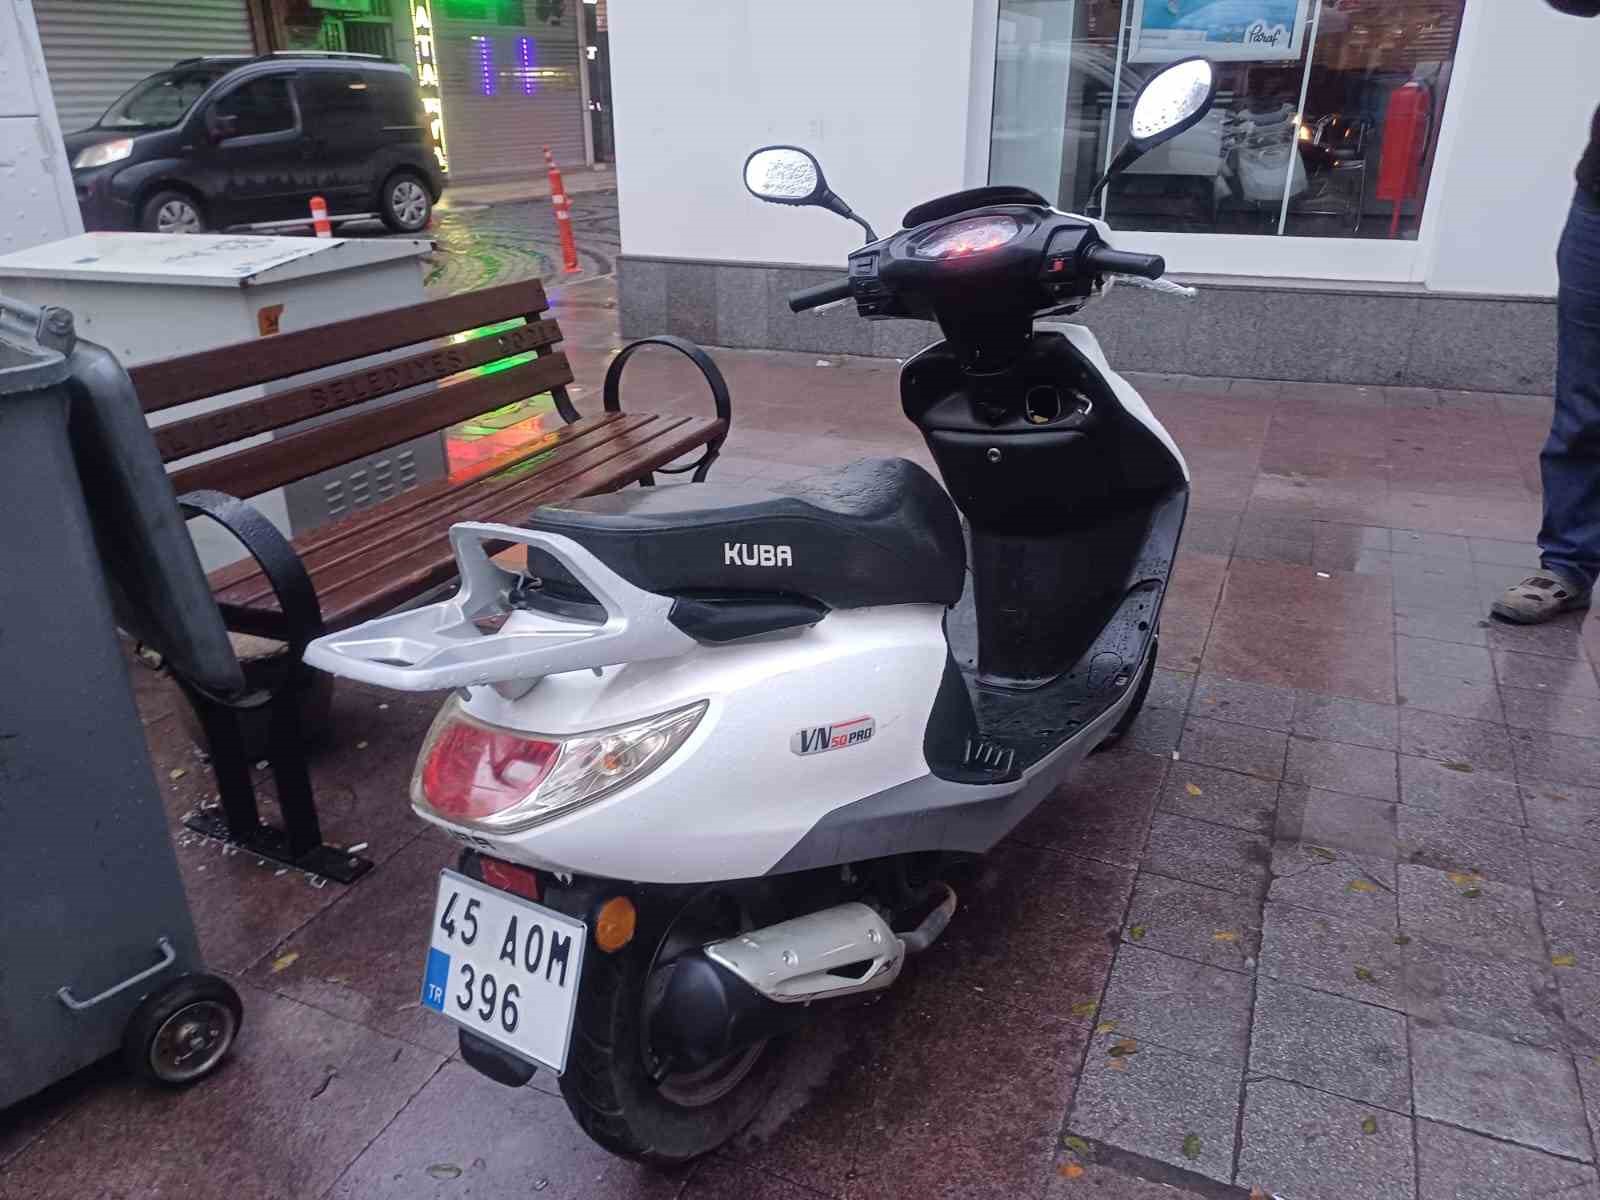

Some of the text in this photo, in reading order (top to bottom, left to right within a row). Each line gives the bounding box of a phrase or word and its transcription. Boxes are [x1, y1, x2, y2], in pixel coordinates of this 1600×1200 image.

[1249, 24, 1281, 47] Paraf
[724, 542, 793, 567] KUBA
[440, 891, 572, 987] 45 AOM
[428, 983, 443, 1004] TR
[456, 963, 521, 1033] 396
